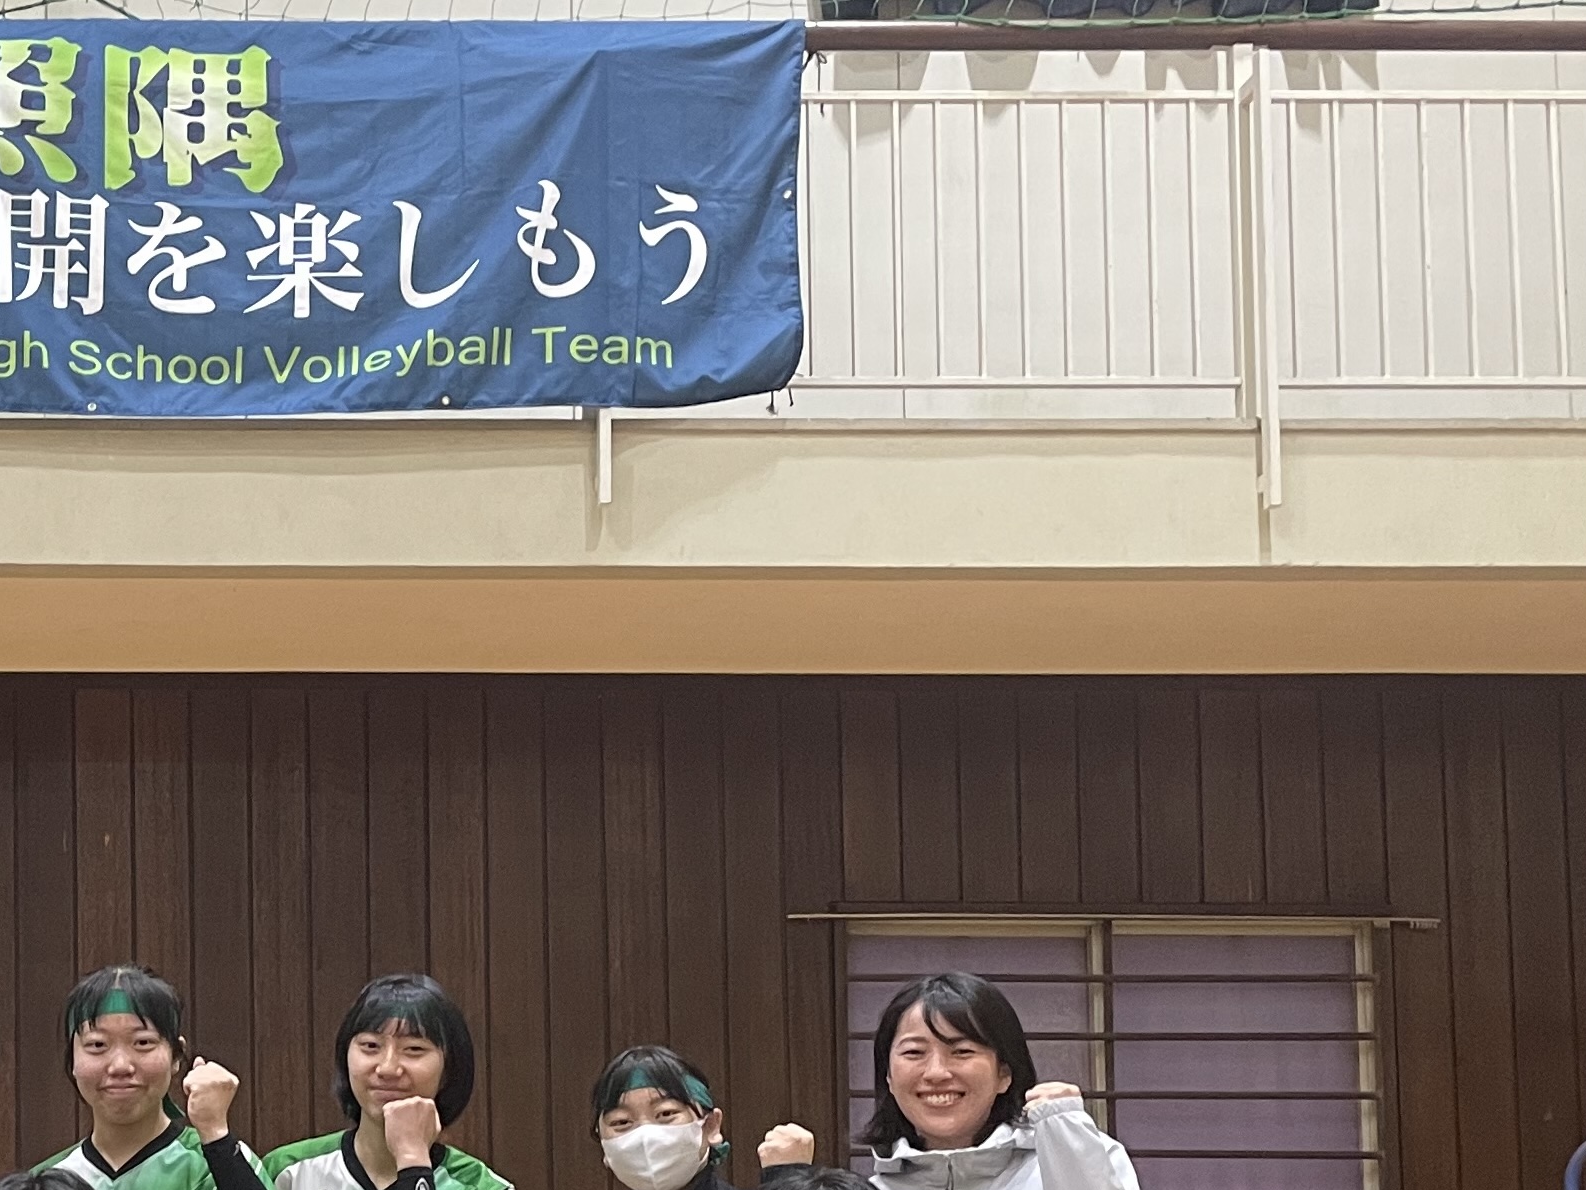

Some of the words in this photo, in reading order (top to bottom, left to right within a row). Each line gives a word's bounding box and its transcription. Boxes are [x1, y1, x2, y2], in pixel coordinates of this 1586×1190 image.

[67, 338, 244, 386] School
[263, 327, 514, 384] Volleyball
[531, 325, 675, 369] Team
